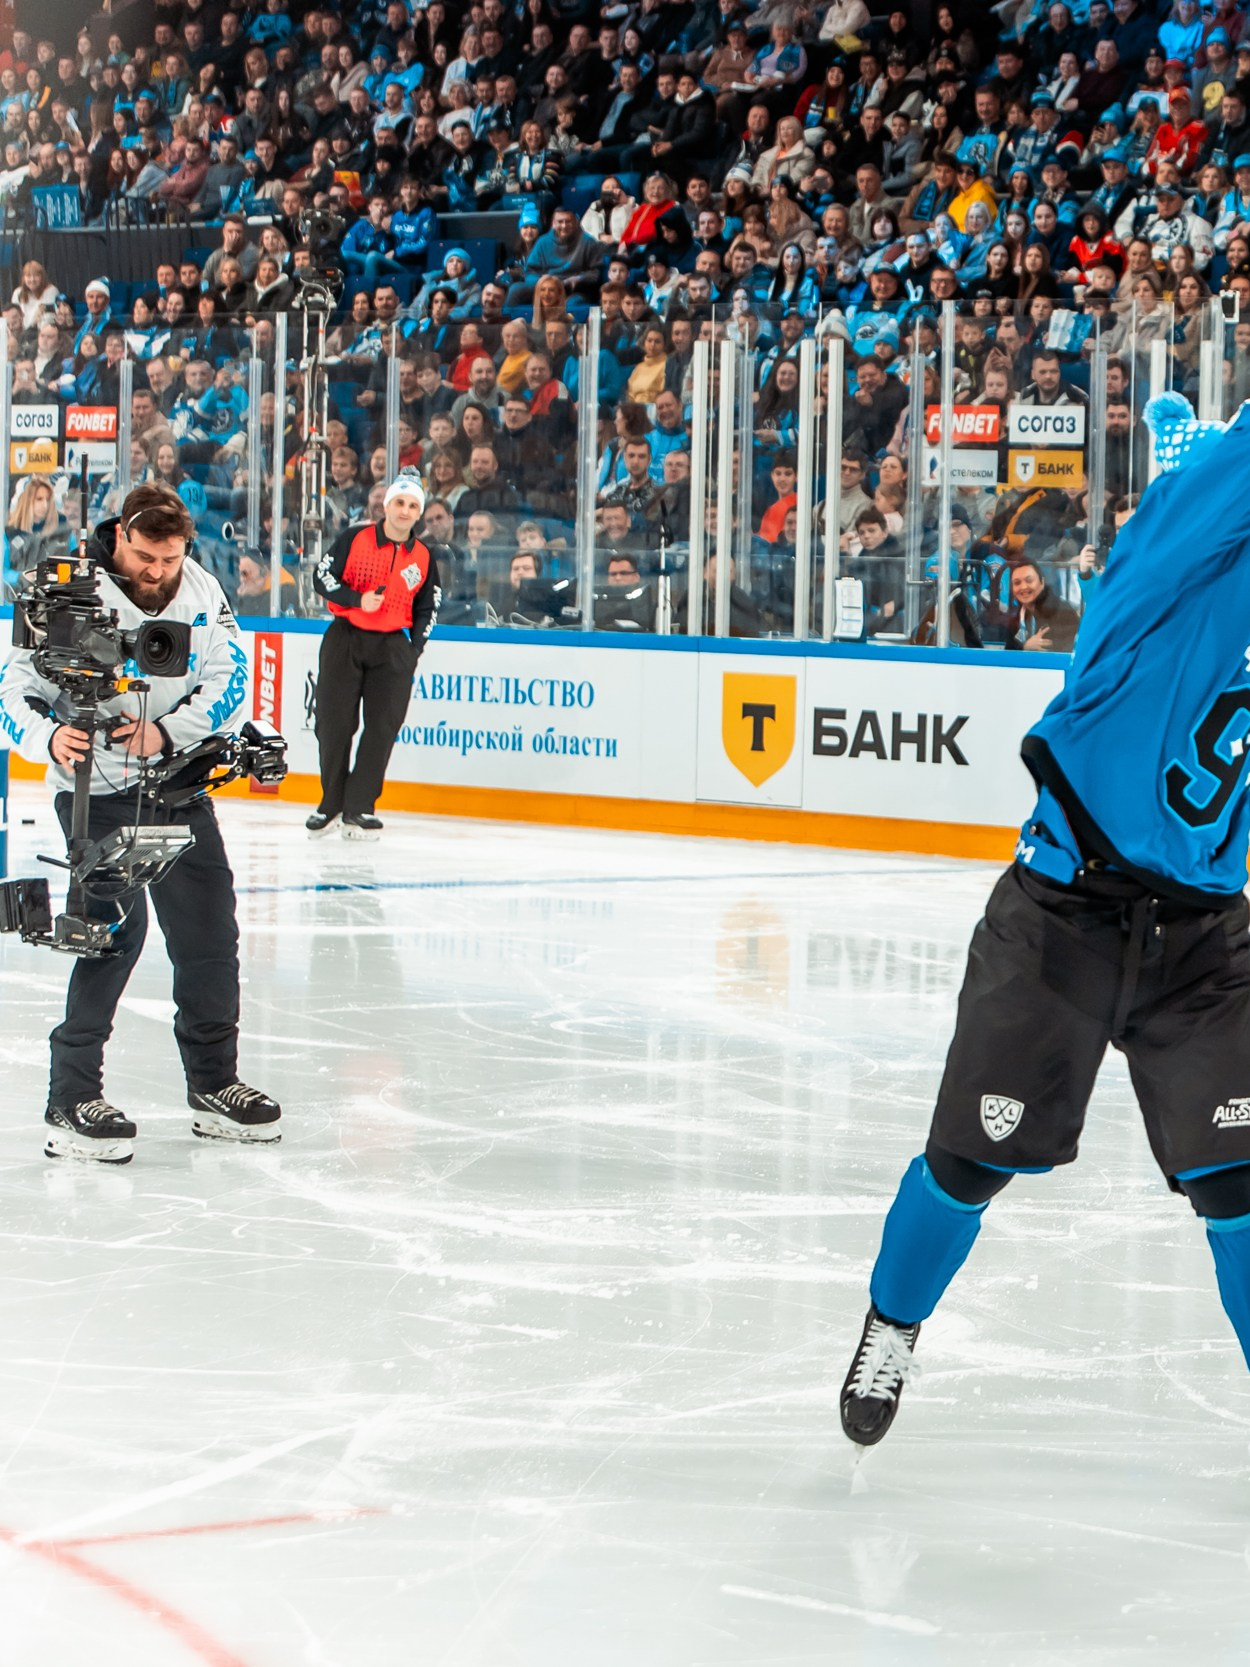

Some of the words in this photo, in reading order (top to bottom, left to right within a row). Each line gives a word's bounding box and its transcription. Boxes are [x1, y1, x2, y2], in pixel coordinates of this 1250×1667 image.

[16, 413, 53, 428] согаз
[67, 413, 116, 432] FONBET
[927, 412, 998, 435] FNBET
[1017, 415, 1077, 433] согаз
[28, 452, 52, 463] БАНК
[1037, 462, 1075, 475] БАНК
[259, 639, 277, 725] NBET
[411, 673, 595, 709] АВИТЕЛЬСТВО
[394, 720, 523, 756] осибирской
[532, 727, 618, 758] области
[813, 706, 970, 766] БАНК
